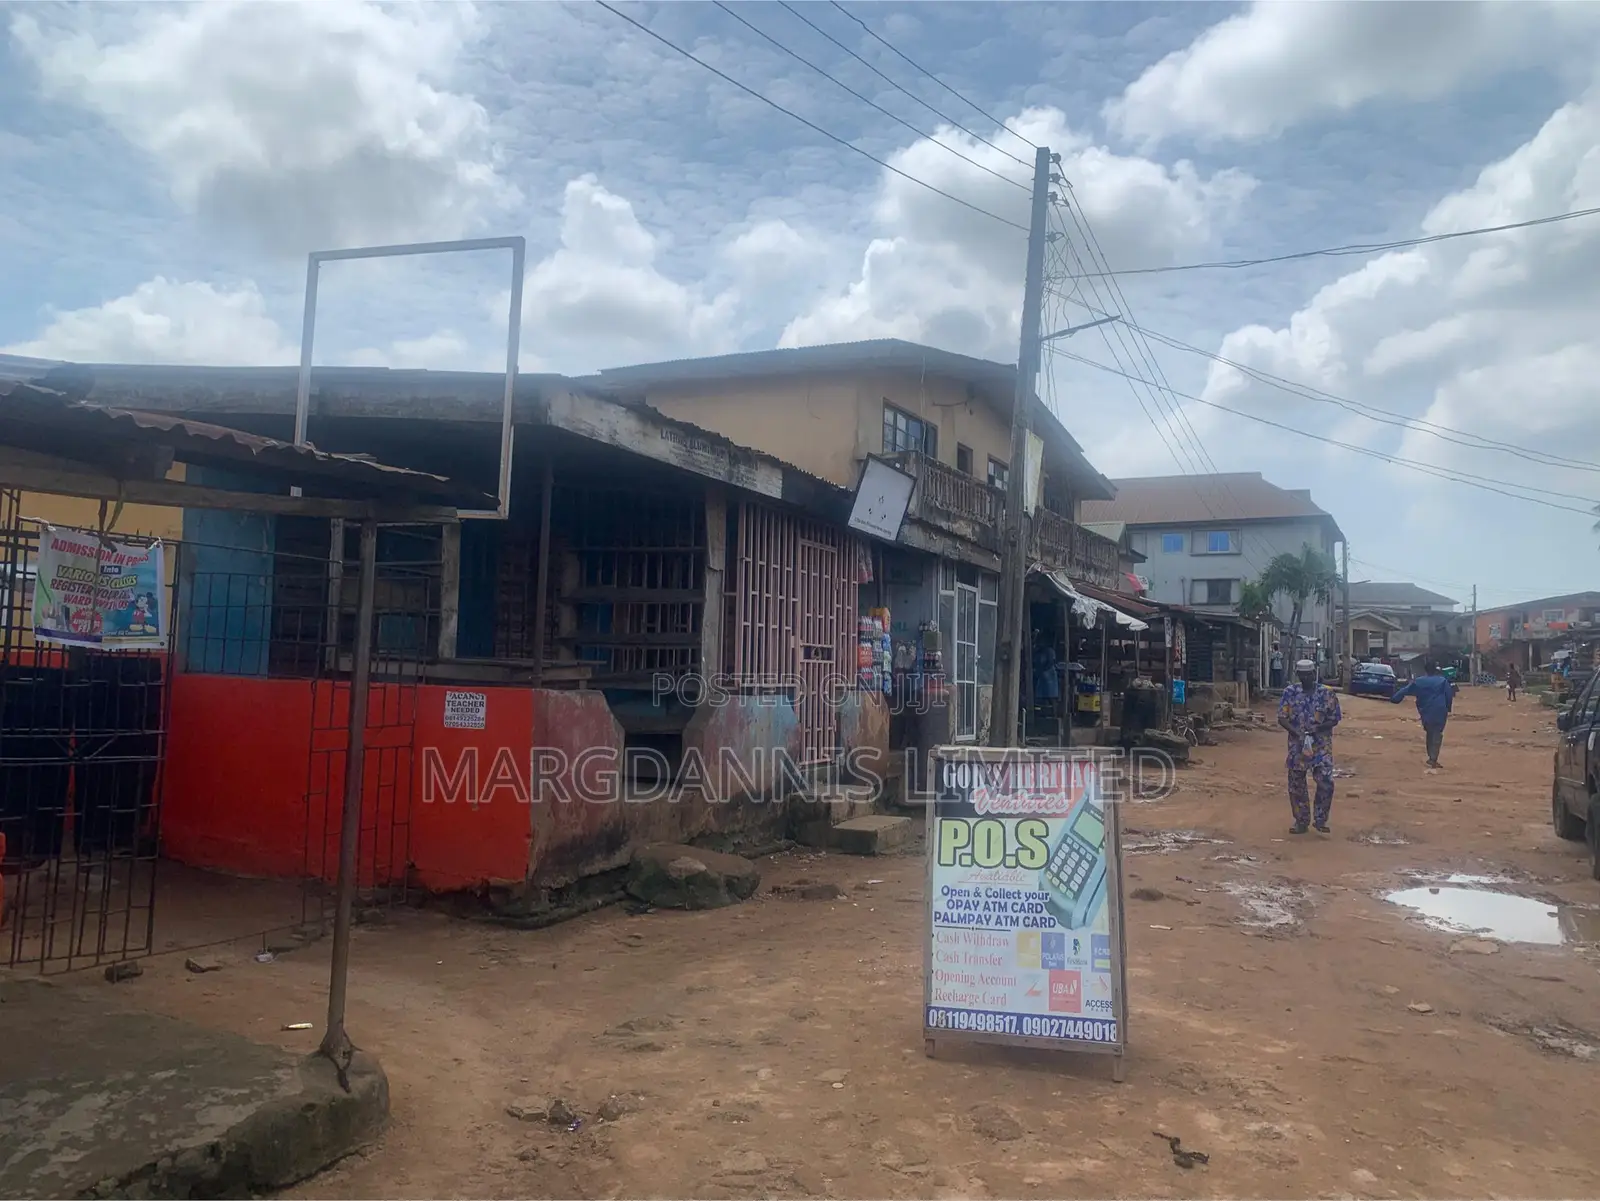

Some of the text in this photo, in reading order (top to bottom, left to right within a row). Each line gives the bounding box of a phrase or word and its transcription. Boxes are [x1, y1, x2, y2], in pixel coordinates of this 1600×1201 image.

[51, 538, 112, 561] ADMISSON
[57, 565, 110, 585] VARIOS
[51, 578, 93, 595] REGISTER
[63, 594, 92, 606] WARD
[446, 700, 485, 708] TEACHER
[943, 761, 1099, 790] GOD'S HERITAG
[974, 787, 1066, 813] Ventures
[938, 818, 1050, 870] P.O.S
[941, 885, 1050, 903] Open & Collect your
[946, 900, 1044, 914] OPAY ATM CARD
[934, 911, 1056, 928] PALMPAY ATM CARD
[936, 931, 1010, 948] Cash Withdraw
[935, 950, 1003, 967] Cash Transfer
[935, 969, 1017, 987] Opening Account
[1052, 982, 1069, 994] UBA
[935, 988, 1007, 1006] Recharge Card
